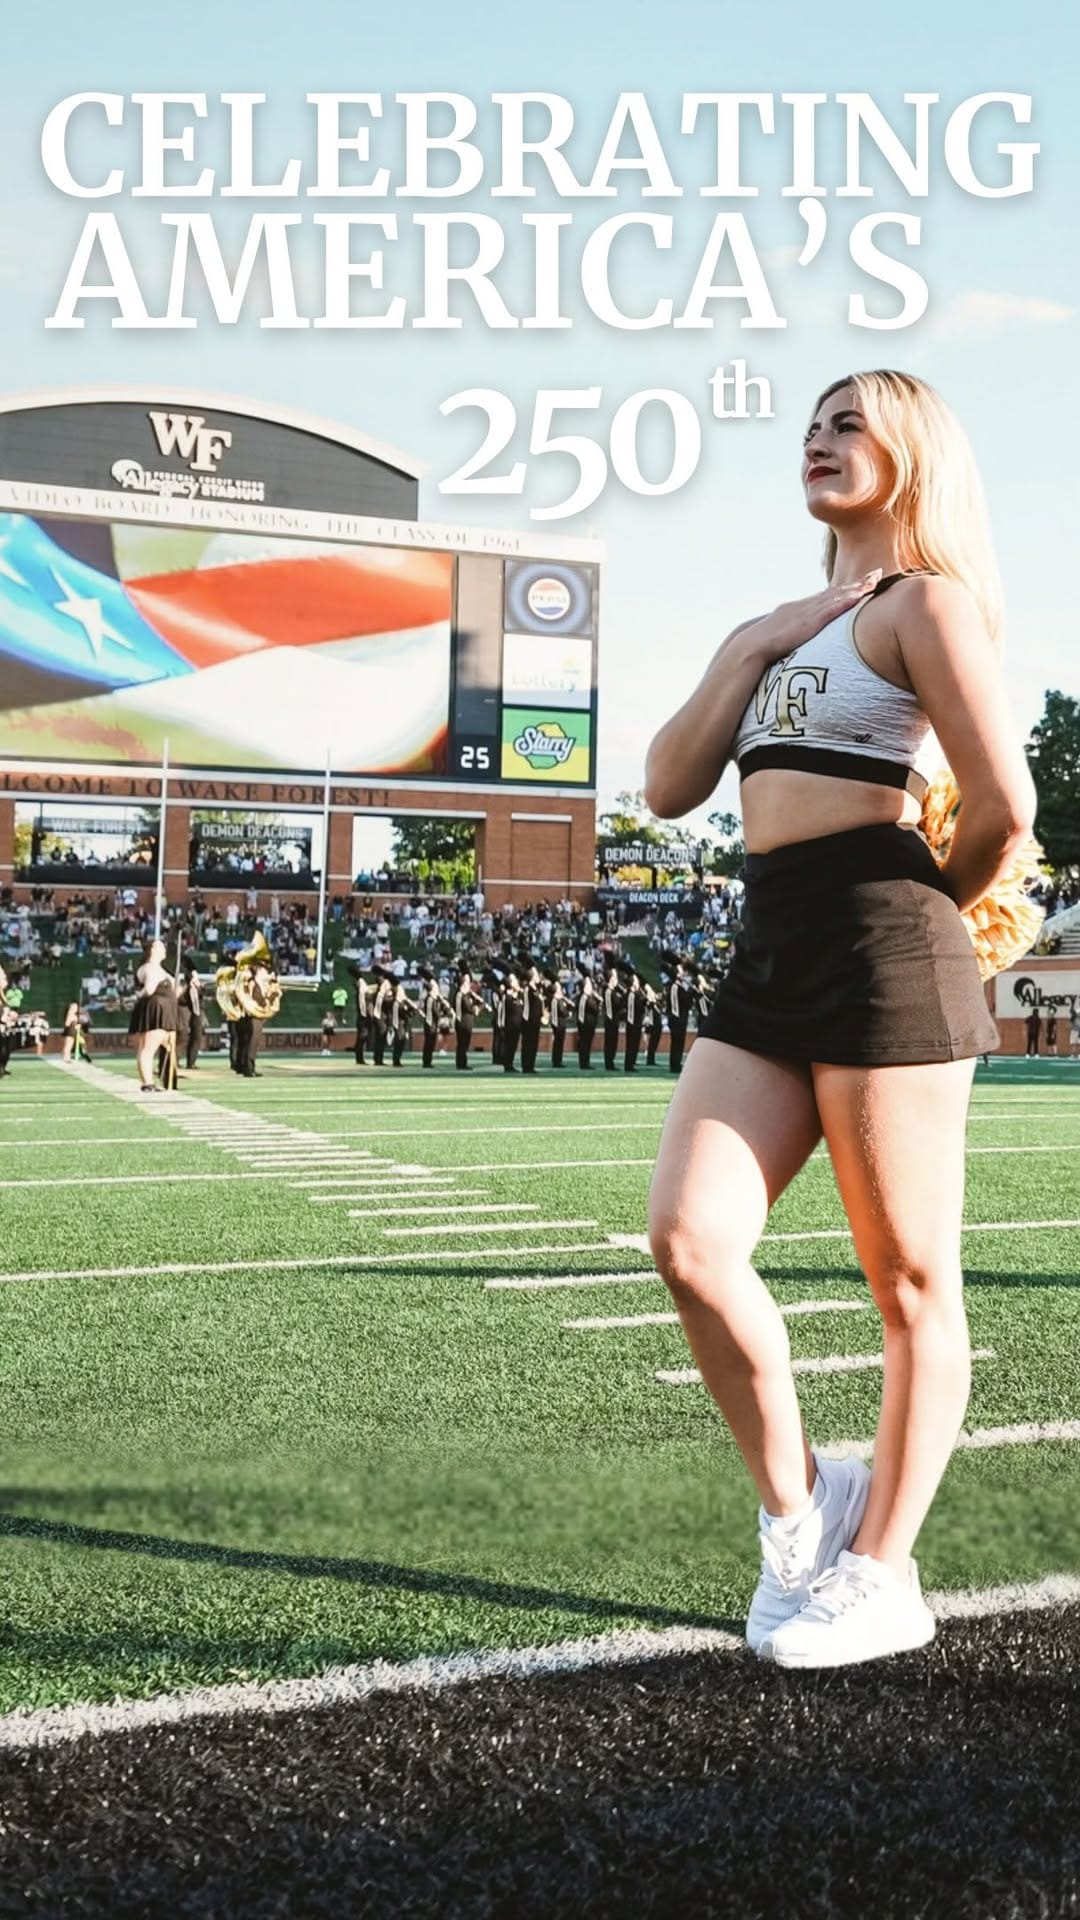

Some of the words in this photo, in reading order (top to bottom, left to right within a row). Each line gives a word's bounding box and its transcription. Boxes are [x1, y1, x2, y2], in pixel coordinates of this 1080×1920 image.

[149, 411, 232, 472] WF
[112, 459, 199, 500] Allegacy
[201, 483, 265, 502] STADIUM
[10, 487, 81, 506] VIDEO
[95, 497, 170, 514] BOARD
[190, 505, 309, 530] HONORING
[460, 746, 490, 770] 25
[513, 726, 576, 764] Starry
[125, 779, 163, 797] TO
[177, 781, 258, 801] WAKE
[271, 784, 390, 807] FOREST!
[201, 824, 243, 838] DEMON
[605, 847, 642, 861] DEMON
[646, 847, 697, 862] DEACONS
[629, 891, 659, 903] DEACON
[660, 892, 679, 904] DECK
[1014, 977, 1077, 1017] Allegacy
[93, 1032, 132, 1049] WAKE
